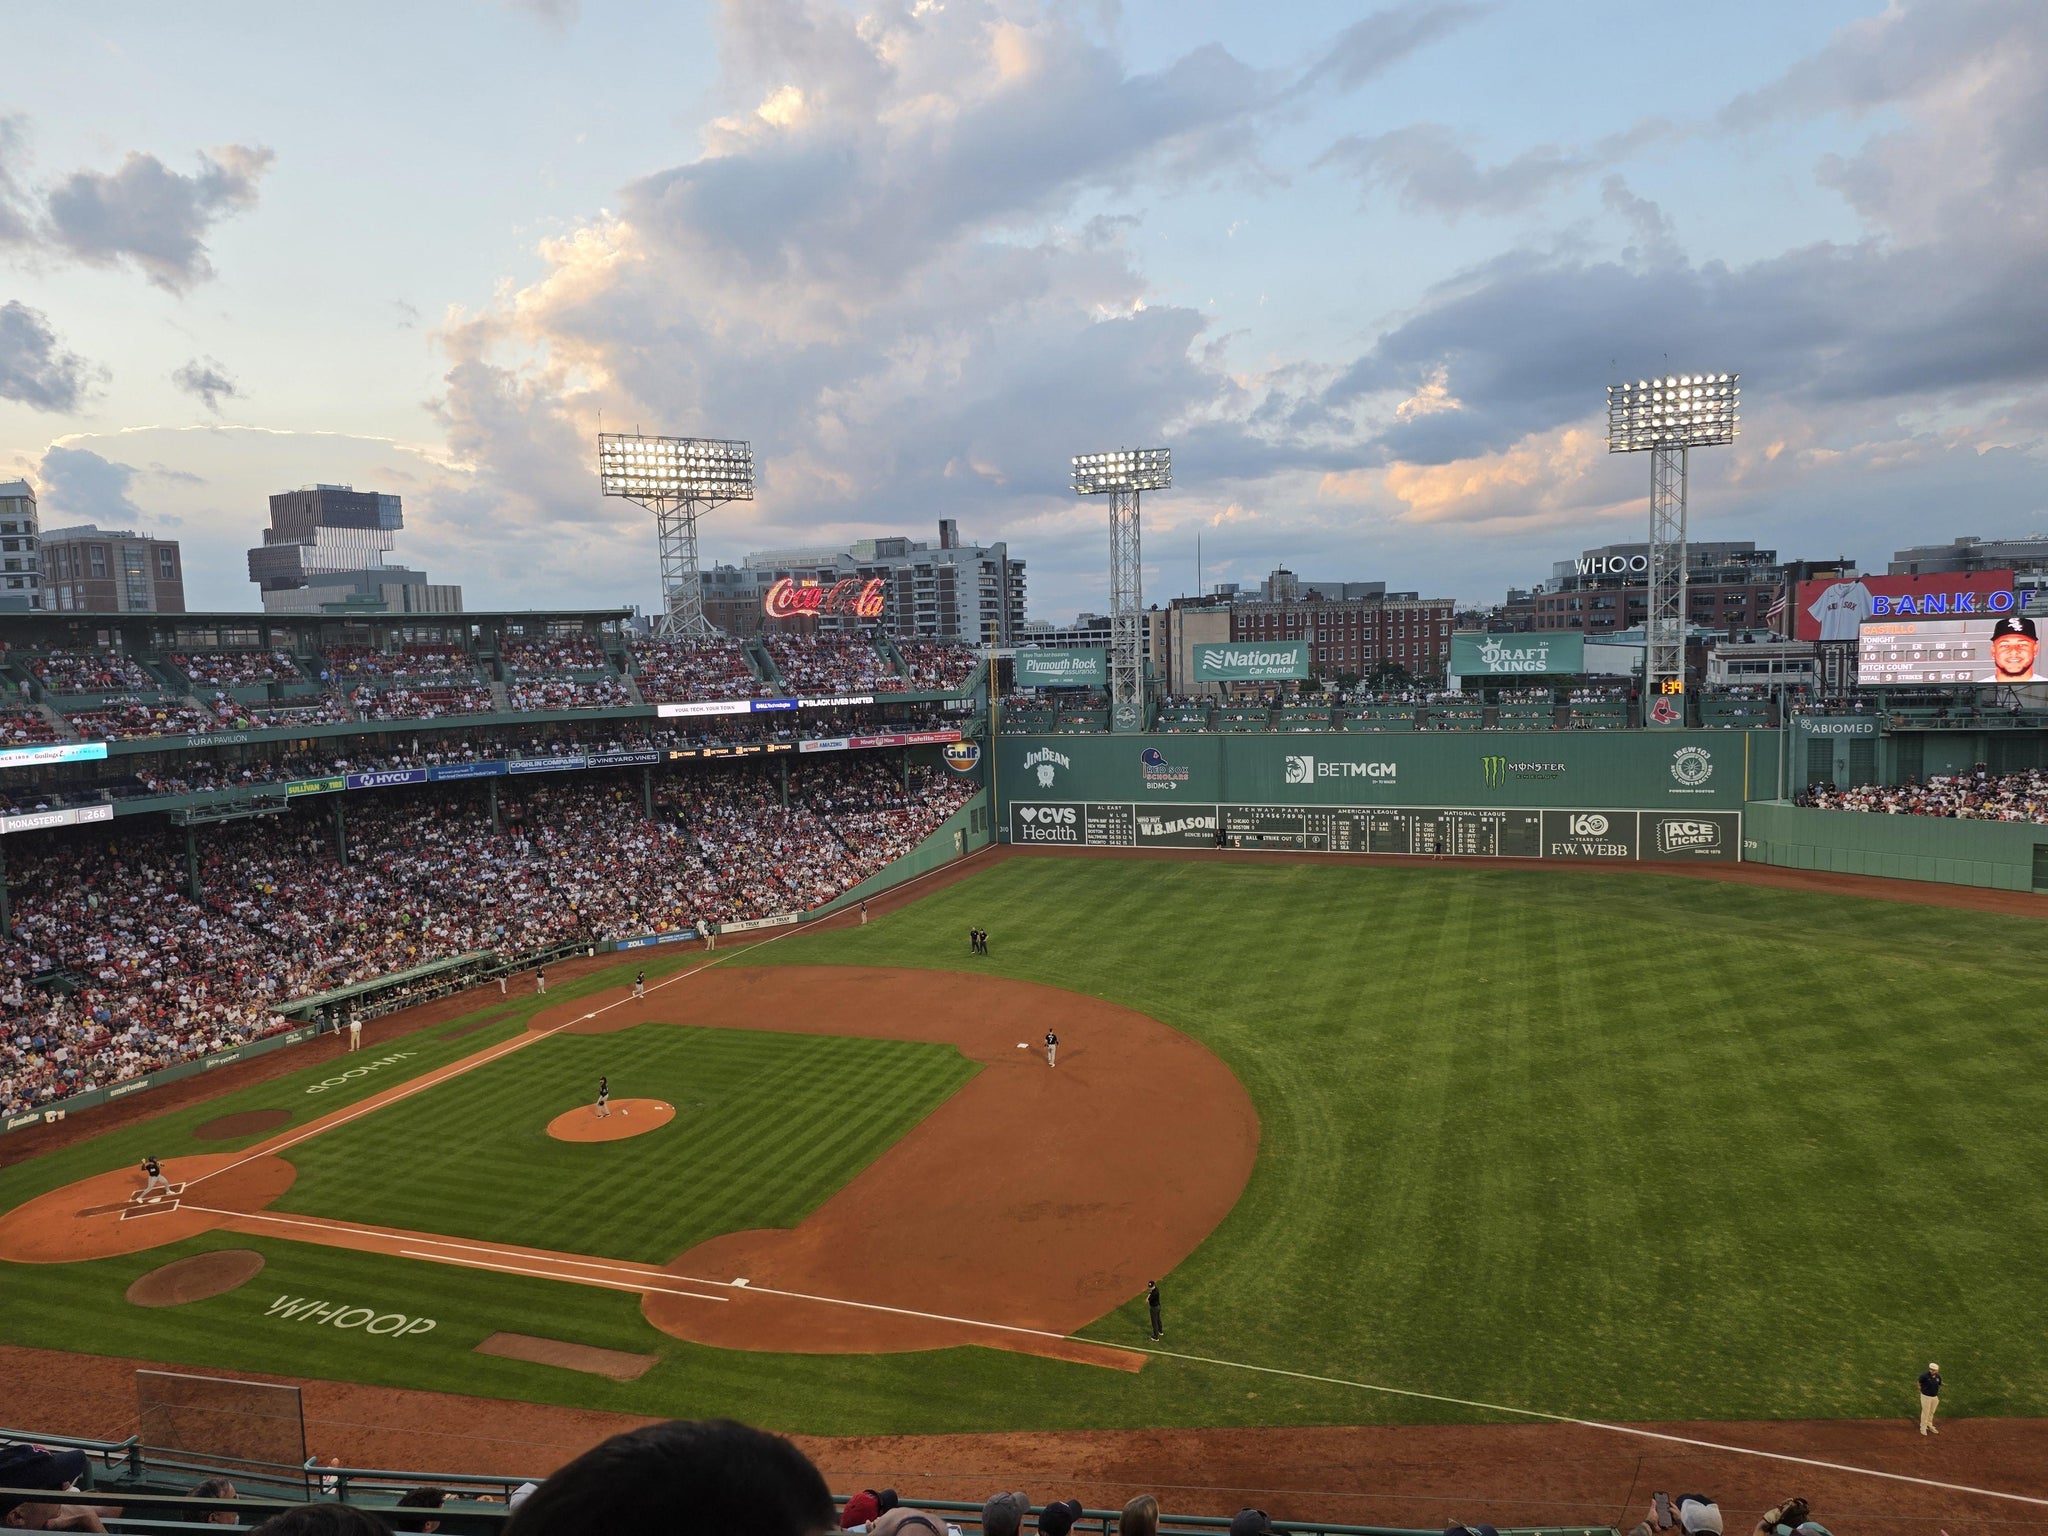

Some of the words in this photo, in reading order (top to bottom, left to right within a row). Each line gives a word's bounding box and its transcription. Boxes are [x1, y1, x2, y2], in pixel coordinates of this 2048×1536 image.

[1843, 601, 1857, 611] SOX
[1872, 592, 1975, 616] BANK
[1988, 590, 2037, 612] OF
[1863, 624, 1916, 634] CASTILLO
[1224, 649, 1298, 666] National
[1482, 648, 1549, 663] DRAFT
[1026, 658, 1070, 671] Plymouth
[1072, 658, 1096, 669] Rock
[1490, 660, 1547, 672] KINGS
[1661, 681, 1682, 694] 1:39
[810, 698, 830, 706] BLACK
[1812, 724, 1873, 734] ABIOMED
[214, 735, 248, 744] PAVILION
[944, 745, 978, 759] Gulf
[1673, 746, 1696, 759] IBEW
[1697, 747, 1711, 759] 103
[596, 755, 633, 764] VINEYARD
[1317, 763, 1396, 777] BETMGM
[376, 773, 409, 783] HYCU
[288, 784, 319, 794] SULLIVAN
[329, 781, 343, 789] TIRE
[8, 815, 63, 829] MONASTERIO
[84, 810, 105, 820] .266
[1038, 807, 1076, 824] CVS
[1569, 814, 1609, 835] 160
[1669, 822, 1714, 836] ACE
[1022, 824, 1077, 841] Health
[1670, 835, 1714, 846] TICKET
[1552, 844, 1578, 855] F.W.
[1584, 844, 1628, 856] WEBB
[306, 1052, 418, 1093] WHOOP
[110, 1080, 148, 1096] smartwater
[7, 1114, 39, 1129] Franklin
[264, 1295, 436, 1337] WHOOP
